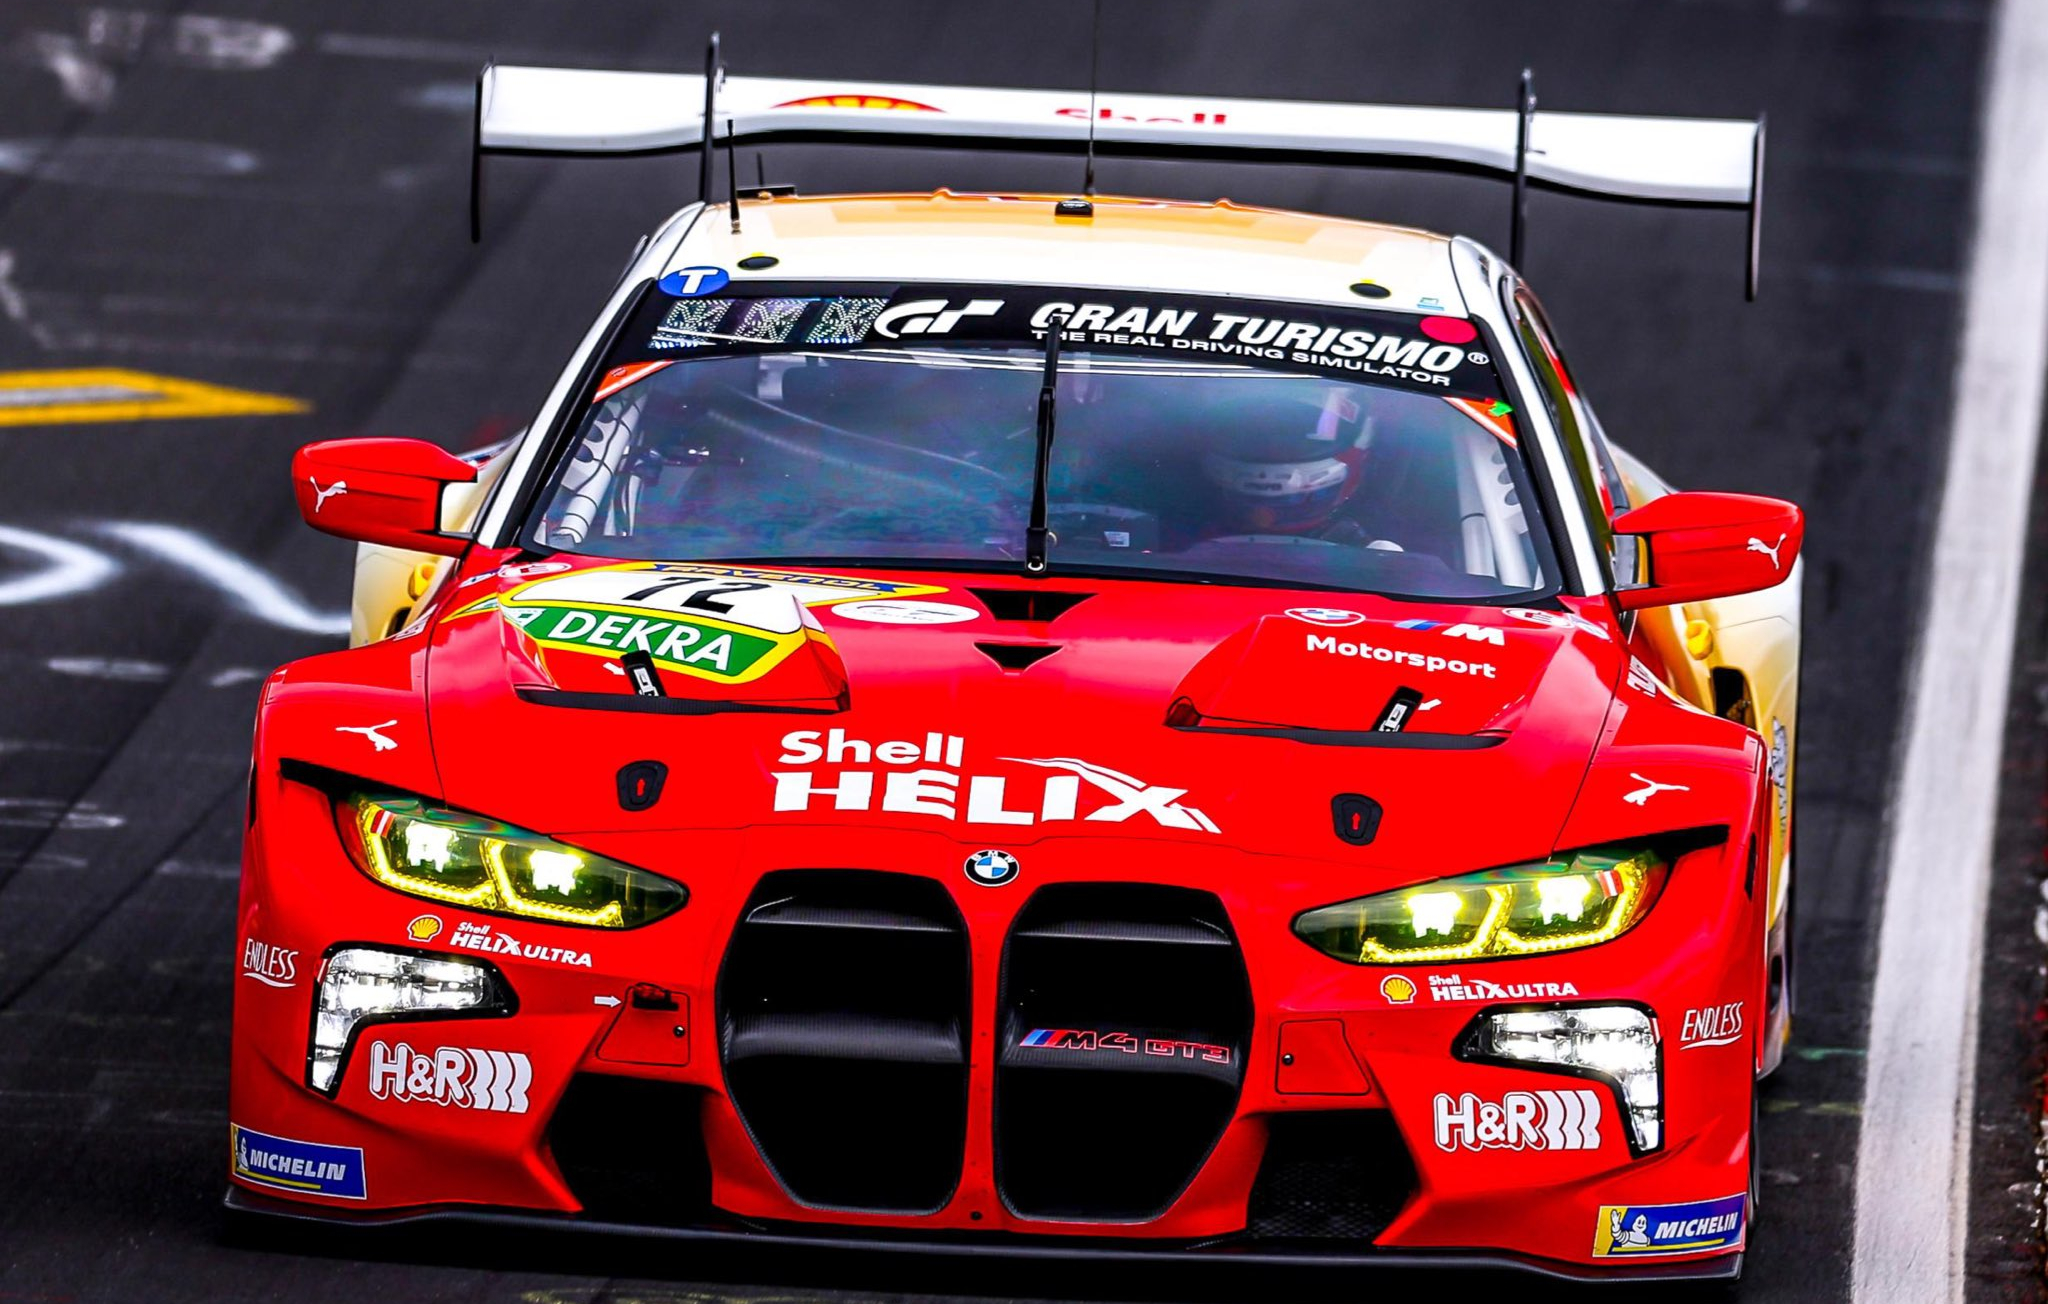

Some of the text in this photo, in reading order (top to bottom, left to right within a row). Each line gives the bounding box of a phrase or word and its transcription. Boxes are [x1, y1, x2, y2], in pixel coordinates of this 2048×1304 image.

[1030, 302, 1198, 336] GRAN
[1094, 332, 1165, 347] REAL
[1172, 338, 1285, 360] DRIVING
[1292, 351, 1451, 387] SIMULATOR
[622, 576, 772, 614] 72
[661, 565, 881, 590] RAVENOL
[548, 609, 734, 673] DEKRA
[1306, 634, 1497, 679] Motorsport
[778, 728, 964, 768] Shell
[770, 757, 1222, 834] HELIX
[457, 921, 491, 935] Shell
[243, 937, 299, 981] ENDLESS
[450, 931, 593, 968] HELIX ULTRA
[1428, 974, 1461, 986] Shell
[1430, 979, 1579, 1002] HELIX ULTRA
[1680, 1001, 1745, 1043] ENDLESS
[1055, 1029, 1230, 1064] M4 GT3
[369, 1041, 476, 1109] H&R
[1433, 1092, 1550, 1153] H&R
[248, 1148, 347, 1182] MICHELIN
[1653, 1209, 1740, 1240] MICHELIN
